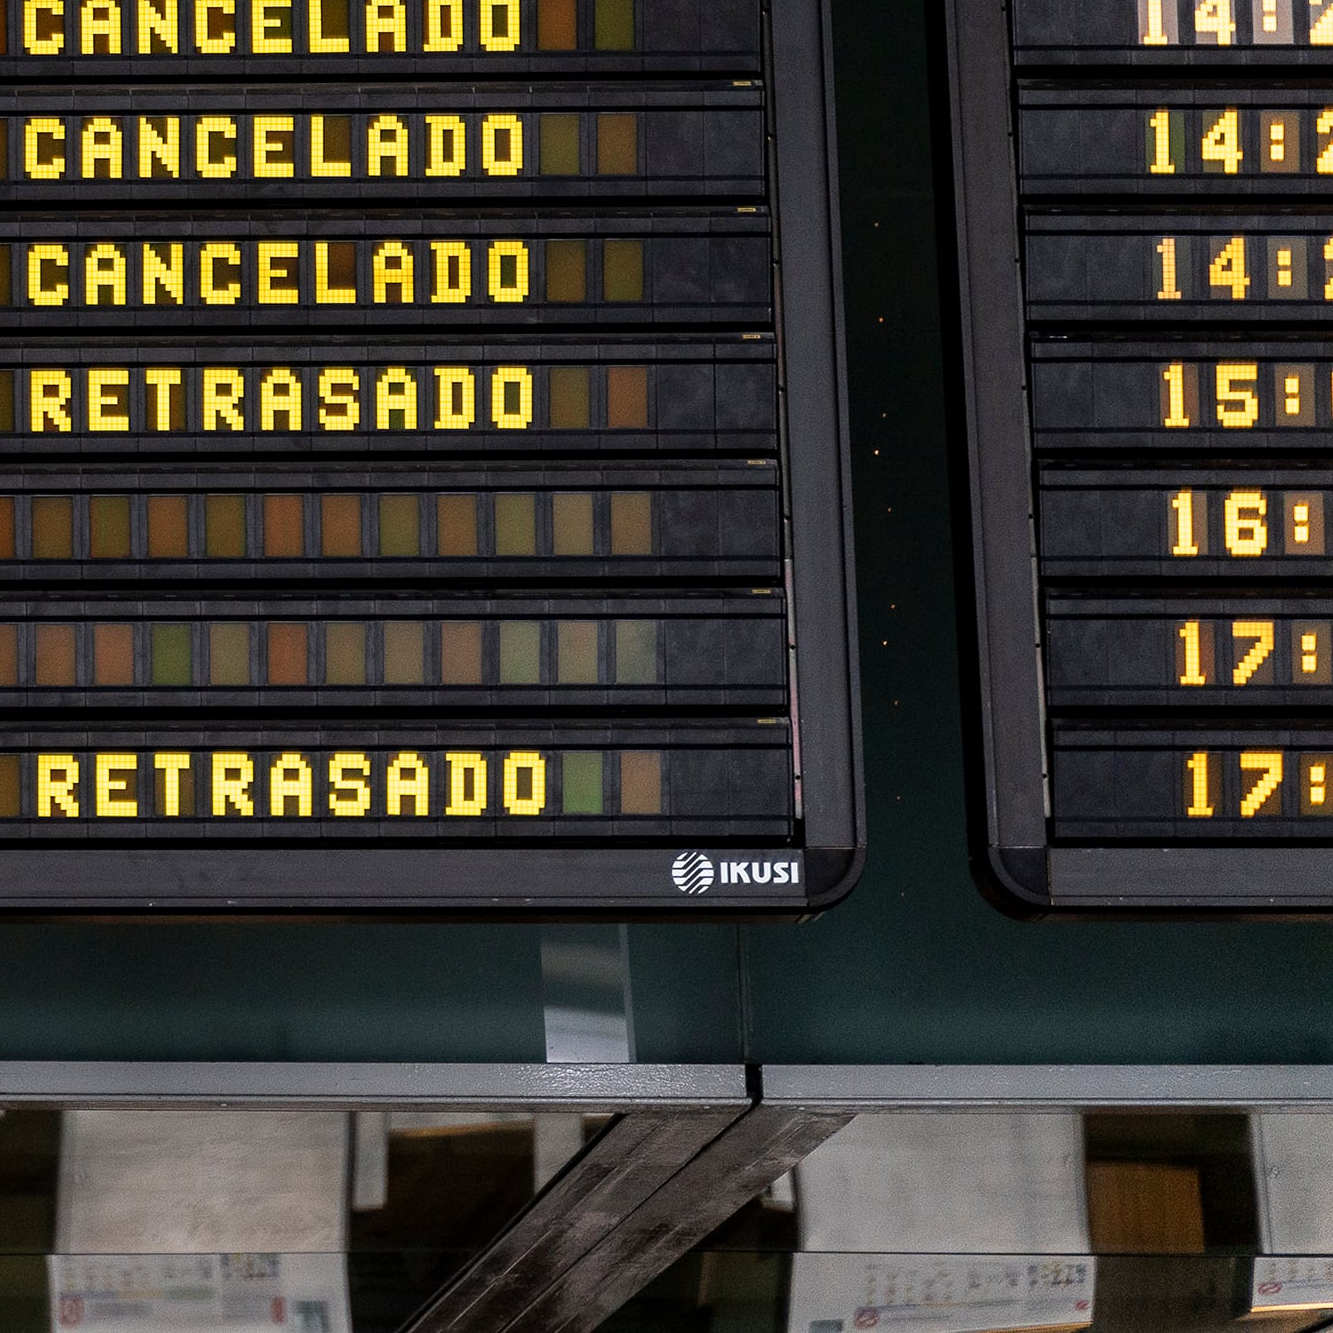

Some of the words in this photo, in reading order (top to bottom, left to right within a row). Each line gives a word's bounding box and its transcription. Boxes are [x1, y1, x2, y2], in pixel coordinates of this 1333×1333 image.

[24, 114, 523, 180] CANCELADO
[28, 241, 529, 306] CANCELADO
[1156, 236, 1333, 300] 14:
[30, 367, 533, 432] RETRASADO
[1163, 363, 1333, 428] 15:
[37, 751, 546, 818] RETRASADO
[719, 861, 800, 884] IKUSI
